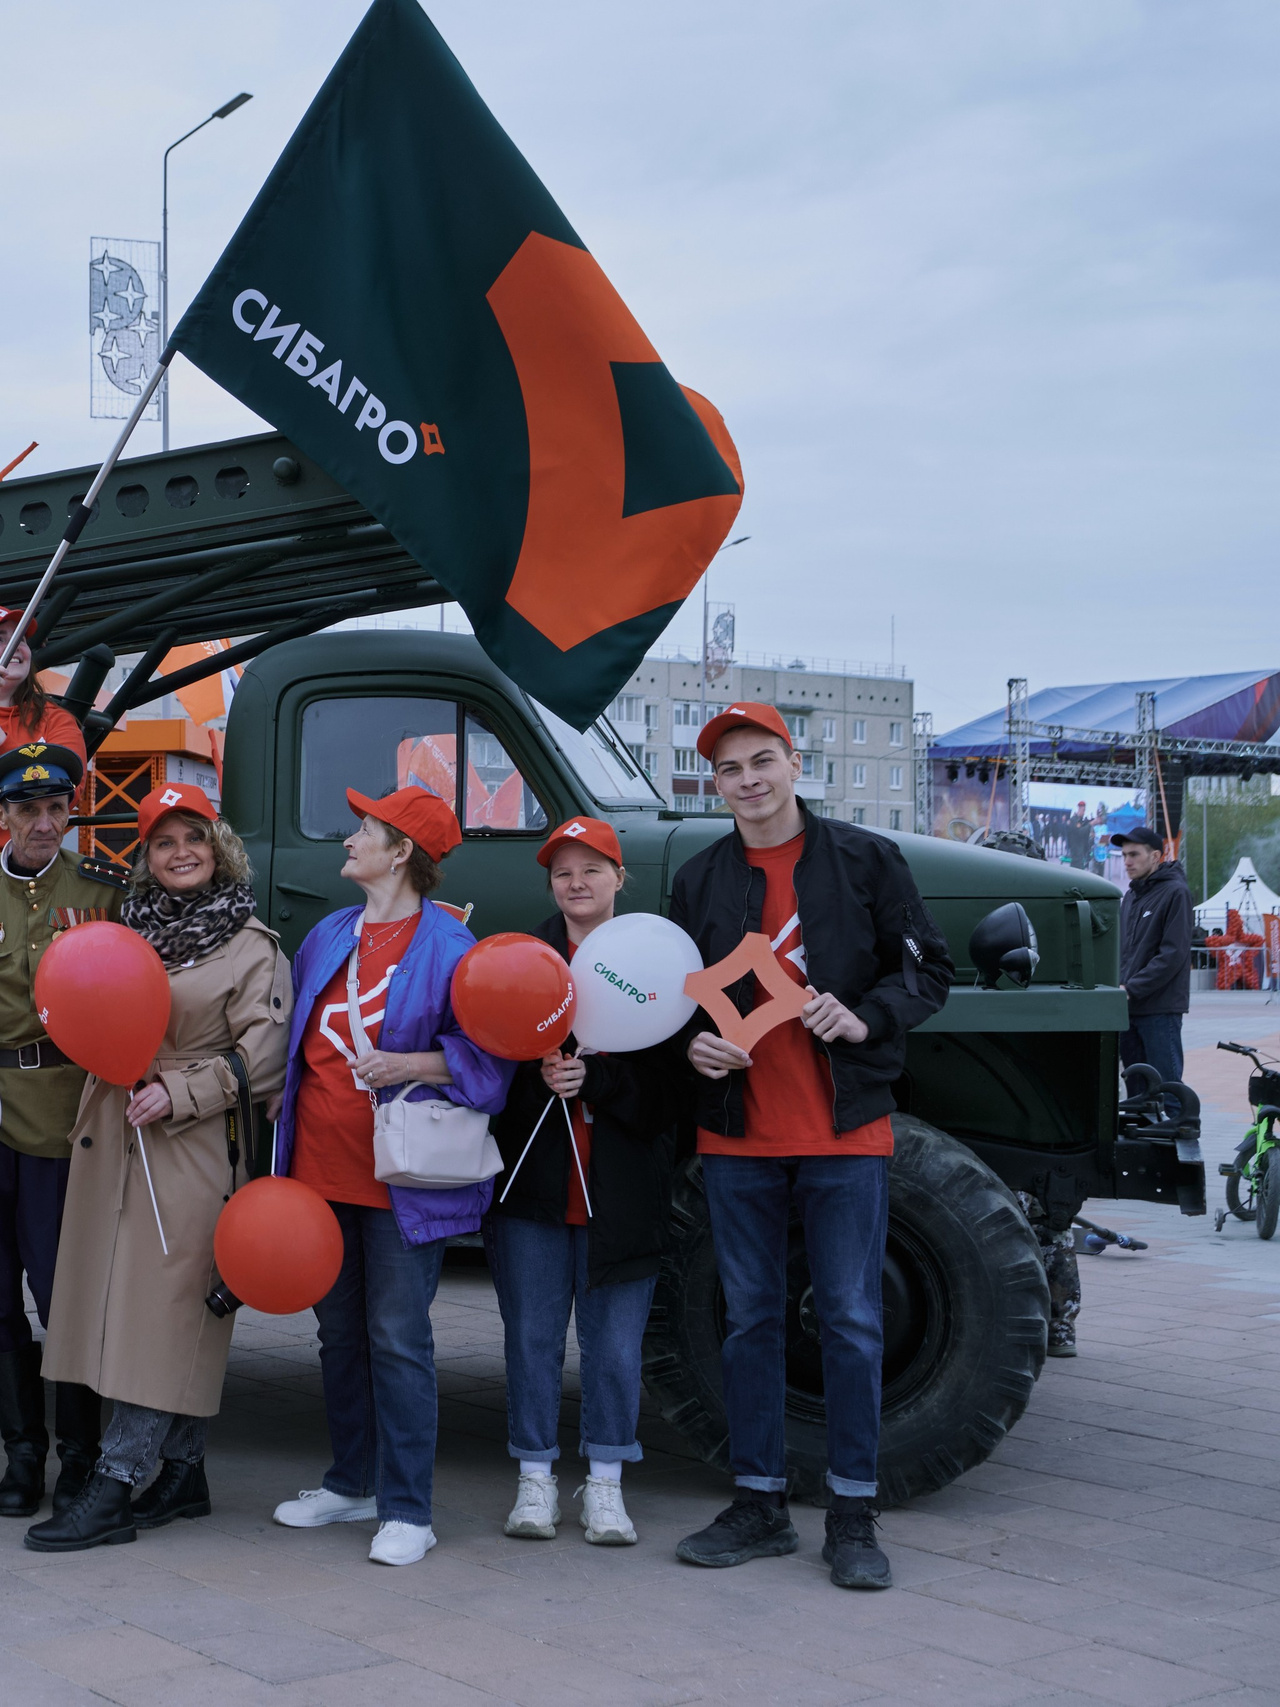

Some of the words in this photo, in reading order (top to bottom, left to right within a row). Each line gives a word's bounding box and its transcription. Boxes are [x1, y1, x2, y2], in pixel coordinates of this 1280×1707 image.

[232, 288, 418, 465] СИБАГРО
[594, 962, 647, 1004] СИБАГРО
[536, 991, 574, 1032] СИБАГРО
